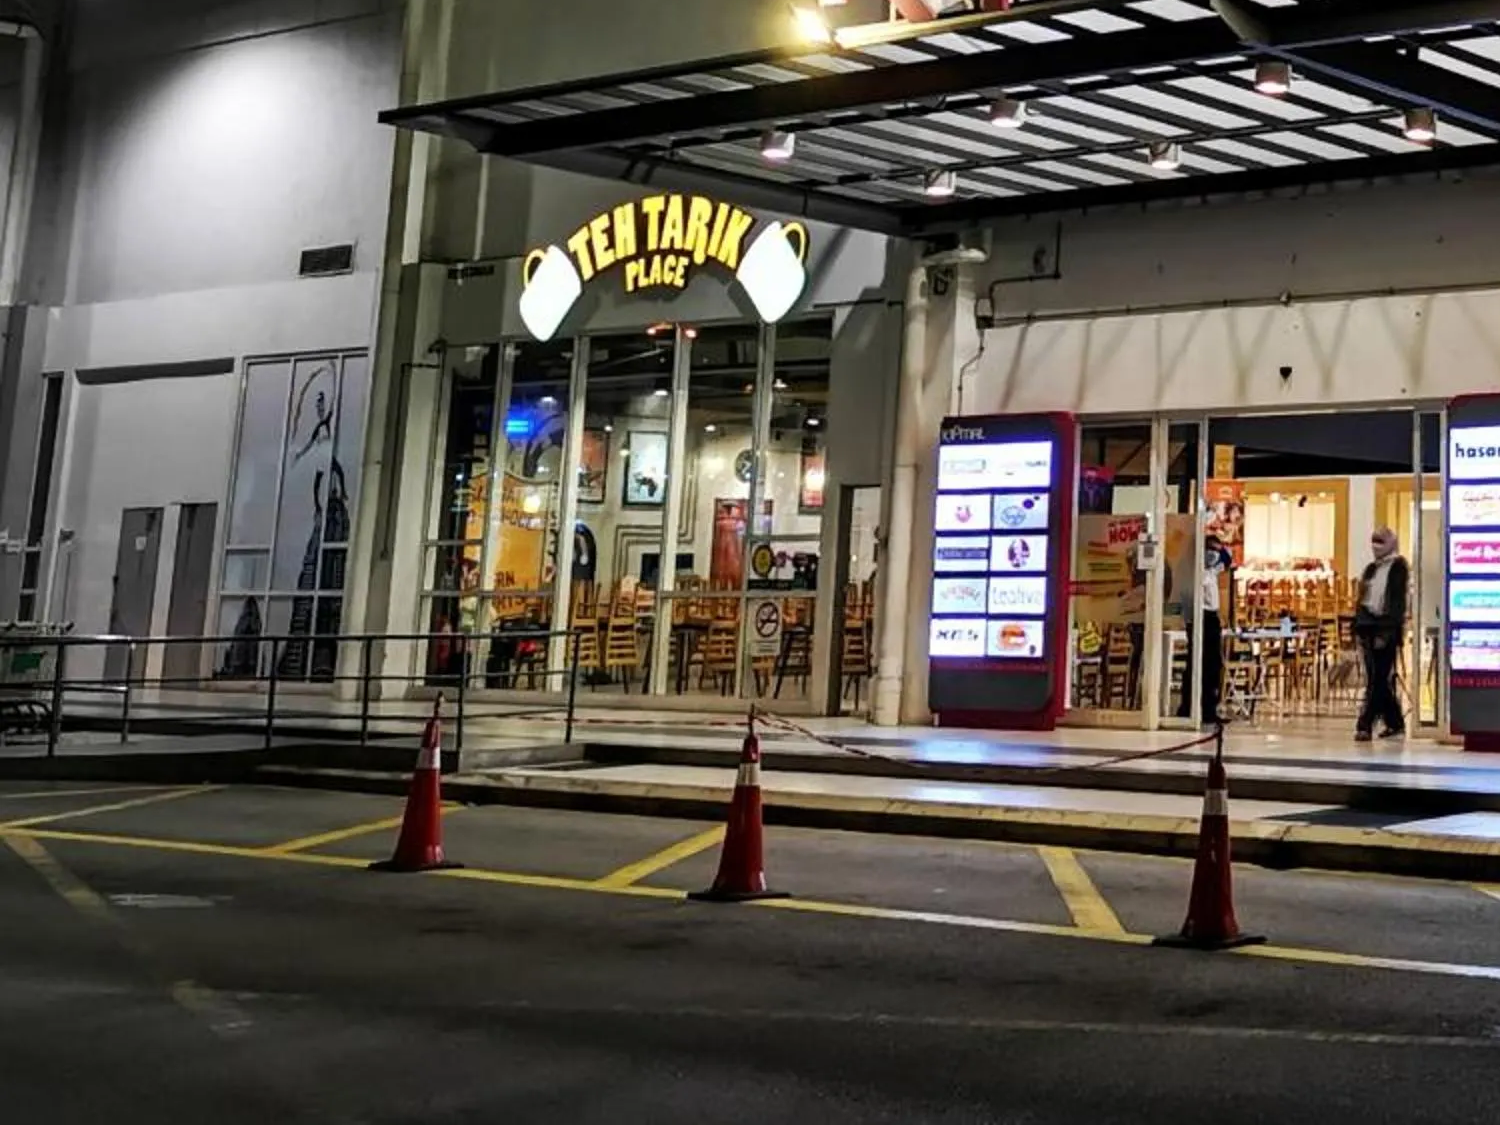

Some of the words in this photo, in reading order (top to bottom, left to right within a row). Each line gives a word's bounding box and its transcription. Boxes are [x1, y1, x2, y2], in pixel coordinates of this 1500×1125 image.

[568, 203, 637, 282] TEH
[642, 194, 753, 270] TARIK
[626, 255, 689, 292] PLACE
